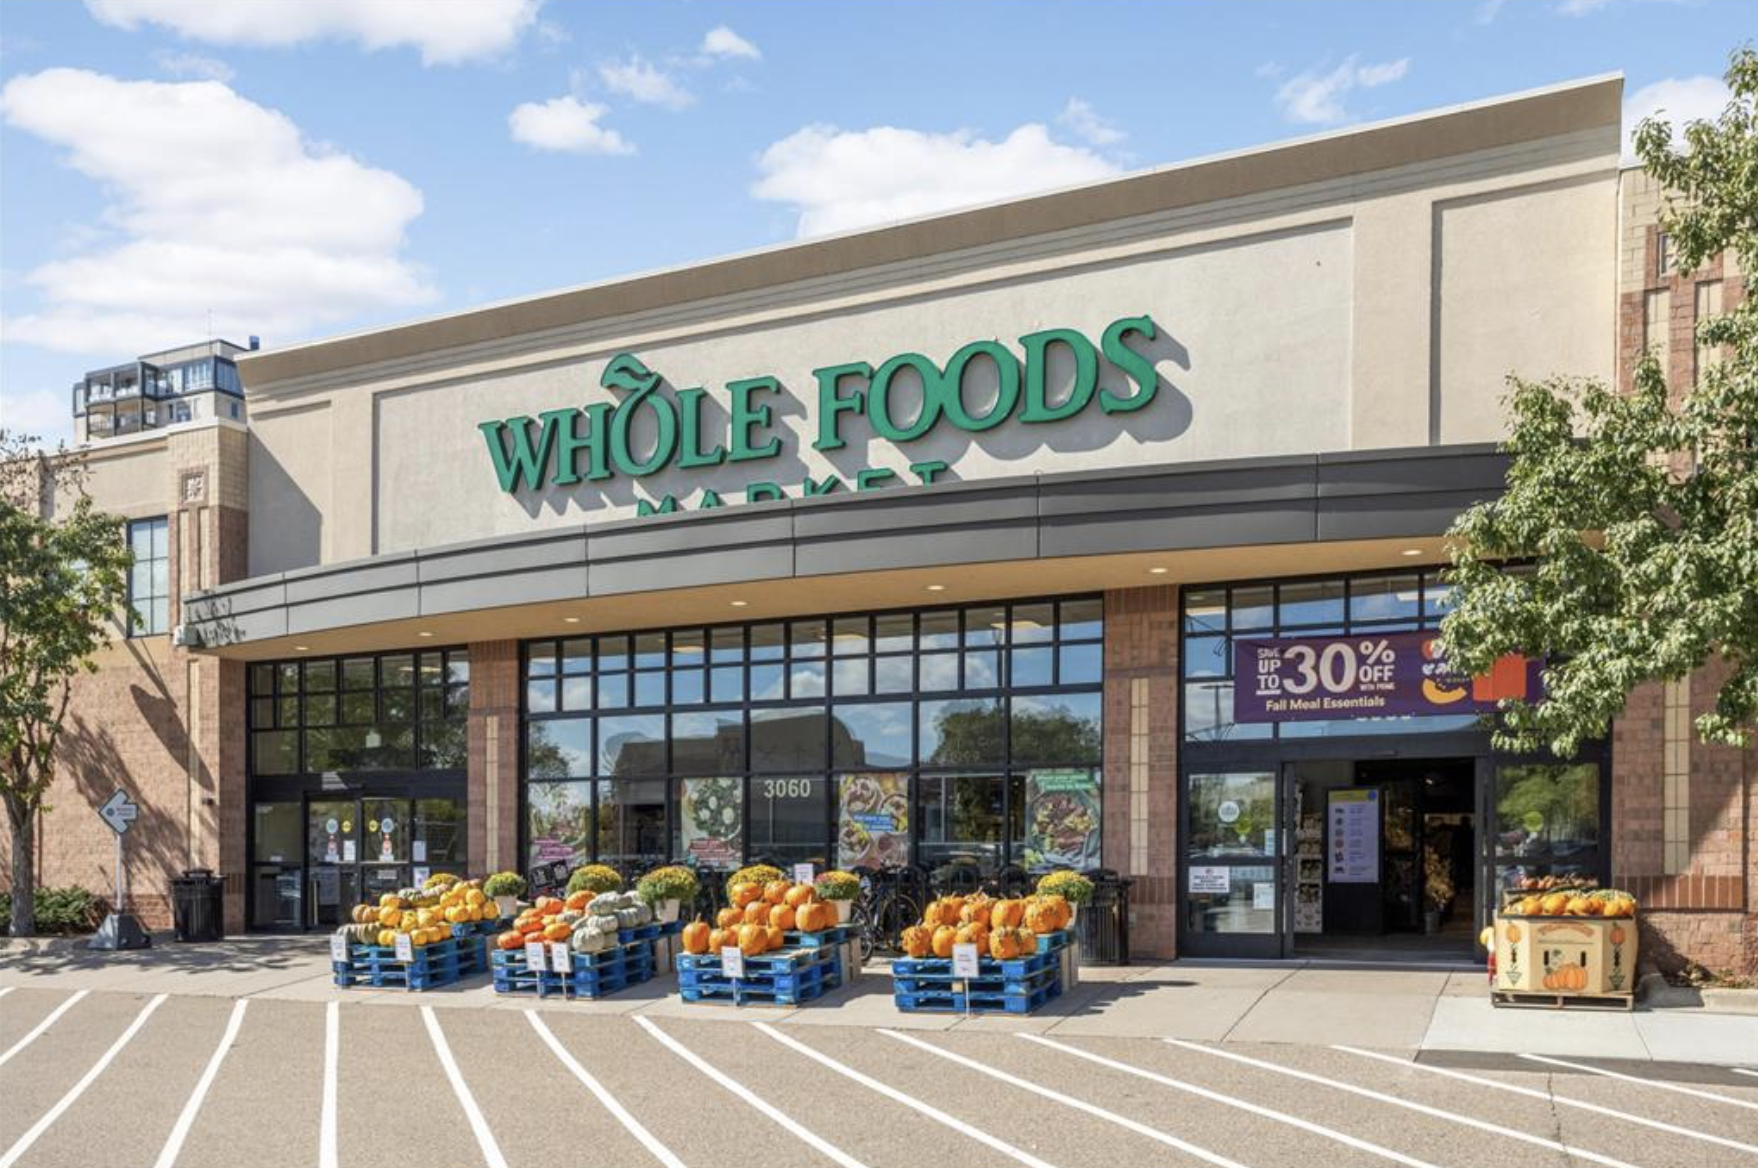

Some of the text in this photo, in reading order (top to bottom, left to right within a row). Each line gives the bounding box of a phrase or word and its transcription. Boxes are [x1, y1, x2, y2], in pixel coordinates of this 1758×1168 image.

[478, 315, 1159, 493] WHOLE FOODS
[1258, 659, 1281, 674] UP
[1359, 664, 1395, 682] OFF
[1257, 675, 1280, 689] TO
[1266, 696, 1386, 711] Fall Meal Essentials
[763, 779, 811, 798] 3060
